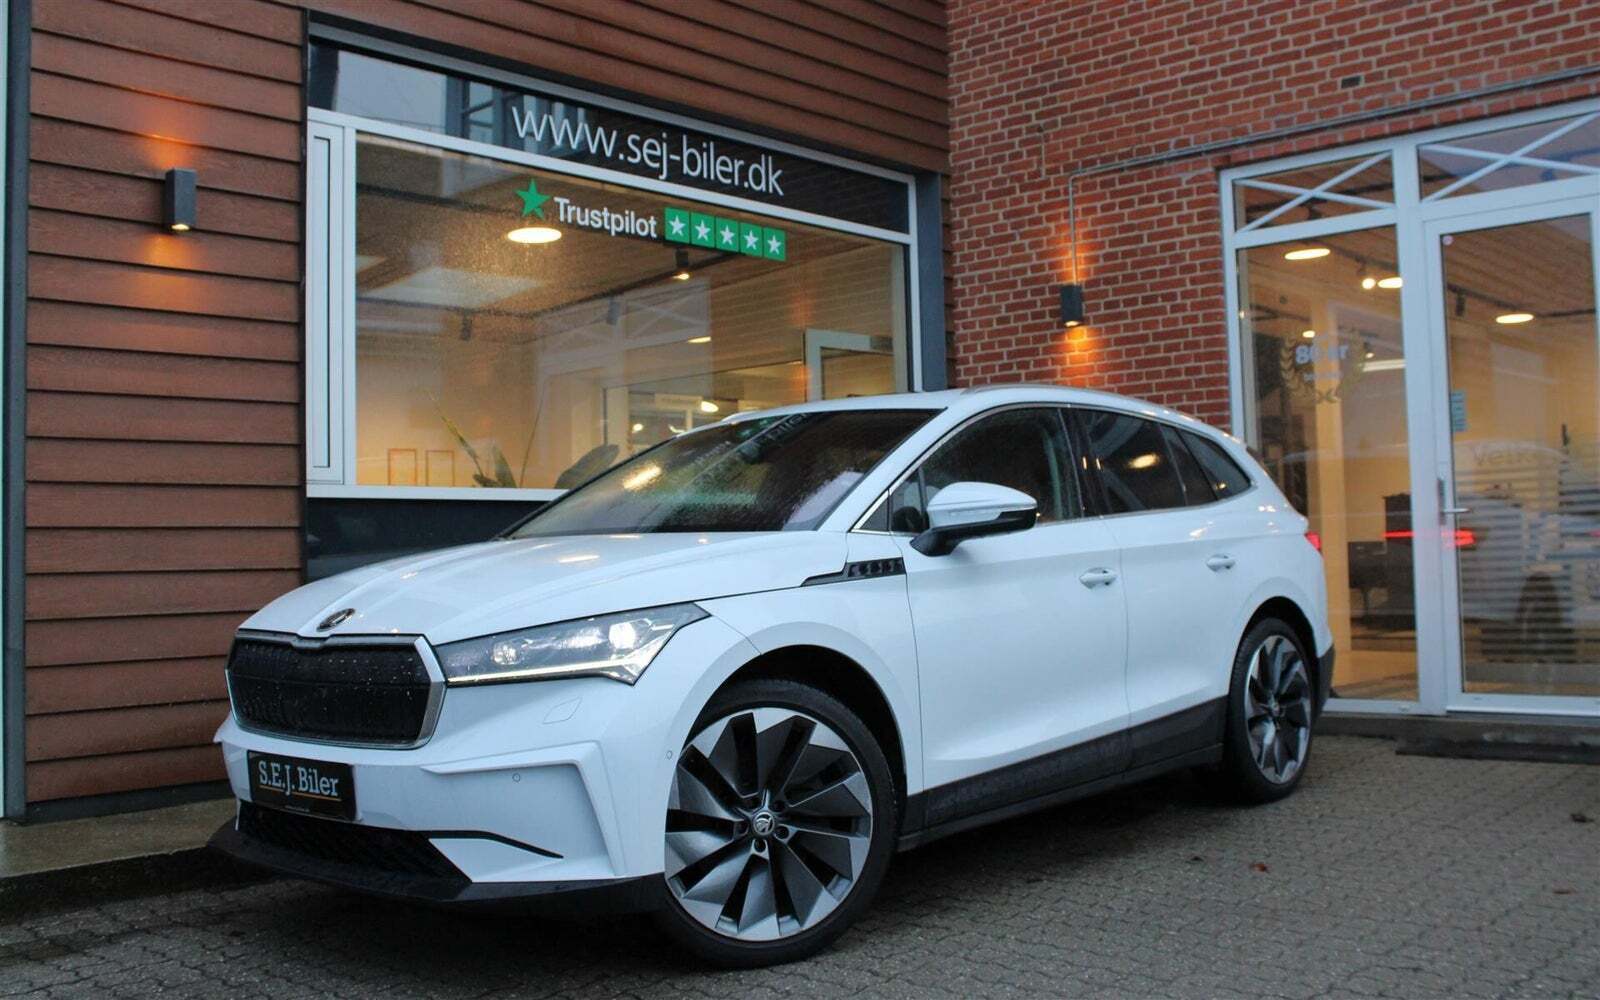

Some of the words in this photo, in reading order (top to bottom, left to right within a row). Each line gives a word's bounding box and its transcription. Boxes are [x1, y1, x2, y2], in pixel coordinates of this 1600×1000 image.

[511, 105, 785, 197] www.sej-biler.dk
[553, 196, 657, 238] Trustpilot
[258, 760, 296, 796] S.E.J.
[297, 766, 340, 797] Biler
